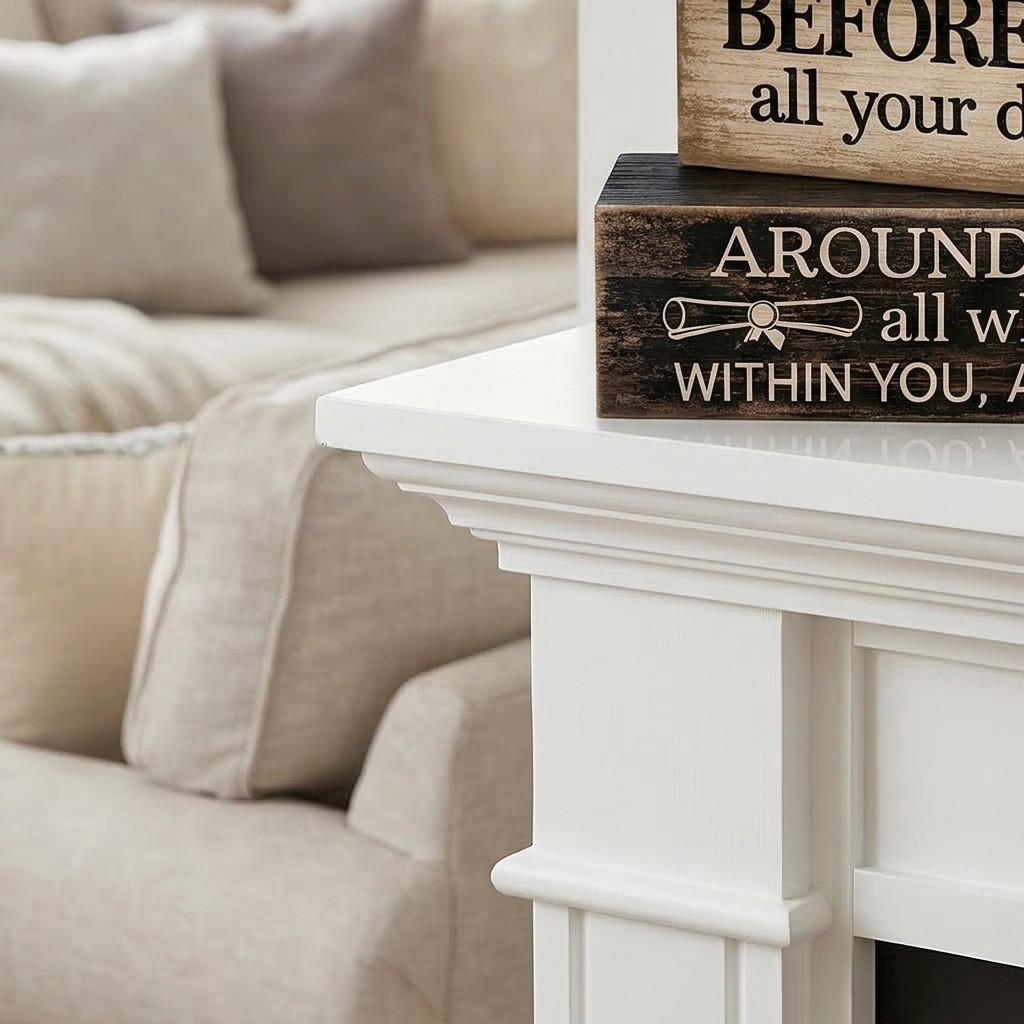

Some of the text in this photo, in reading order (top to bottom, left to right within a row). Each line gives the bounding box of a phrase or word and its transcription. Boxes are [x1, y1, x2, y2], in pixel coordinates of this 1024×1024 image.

[750, 67, 824, 127] all
[842, 89, 976, 145] your
[881, 294, 947, 343] all
[675, 362, 849, 403] WITHIN
[870, 363, 987, 409] YOU,
